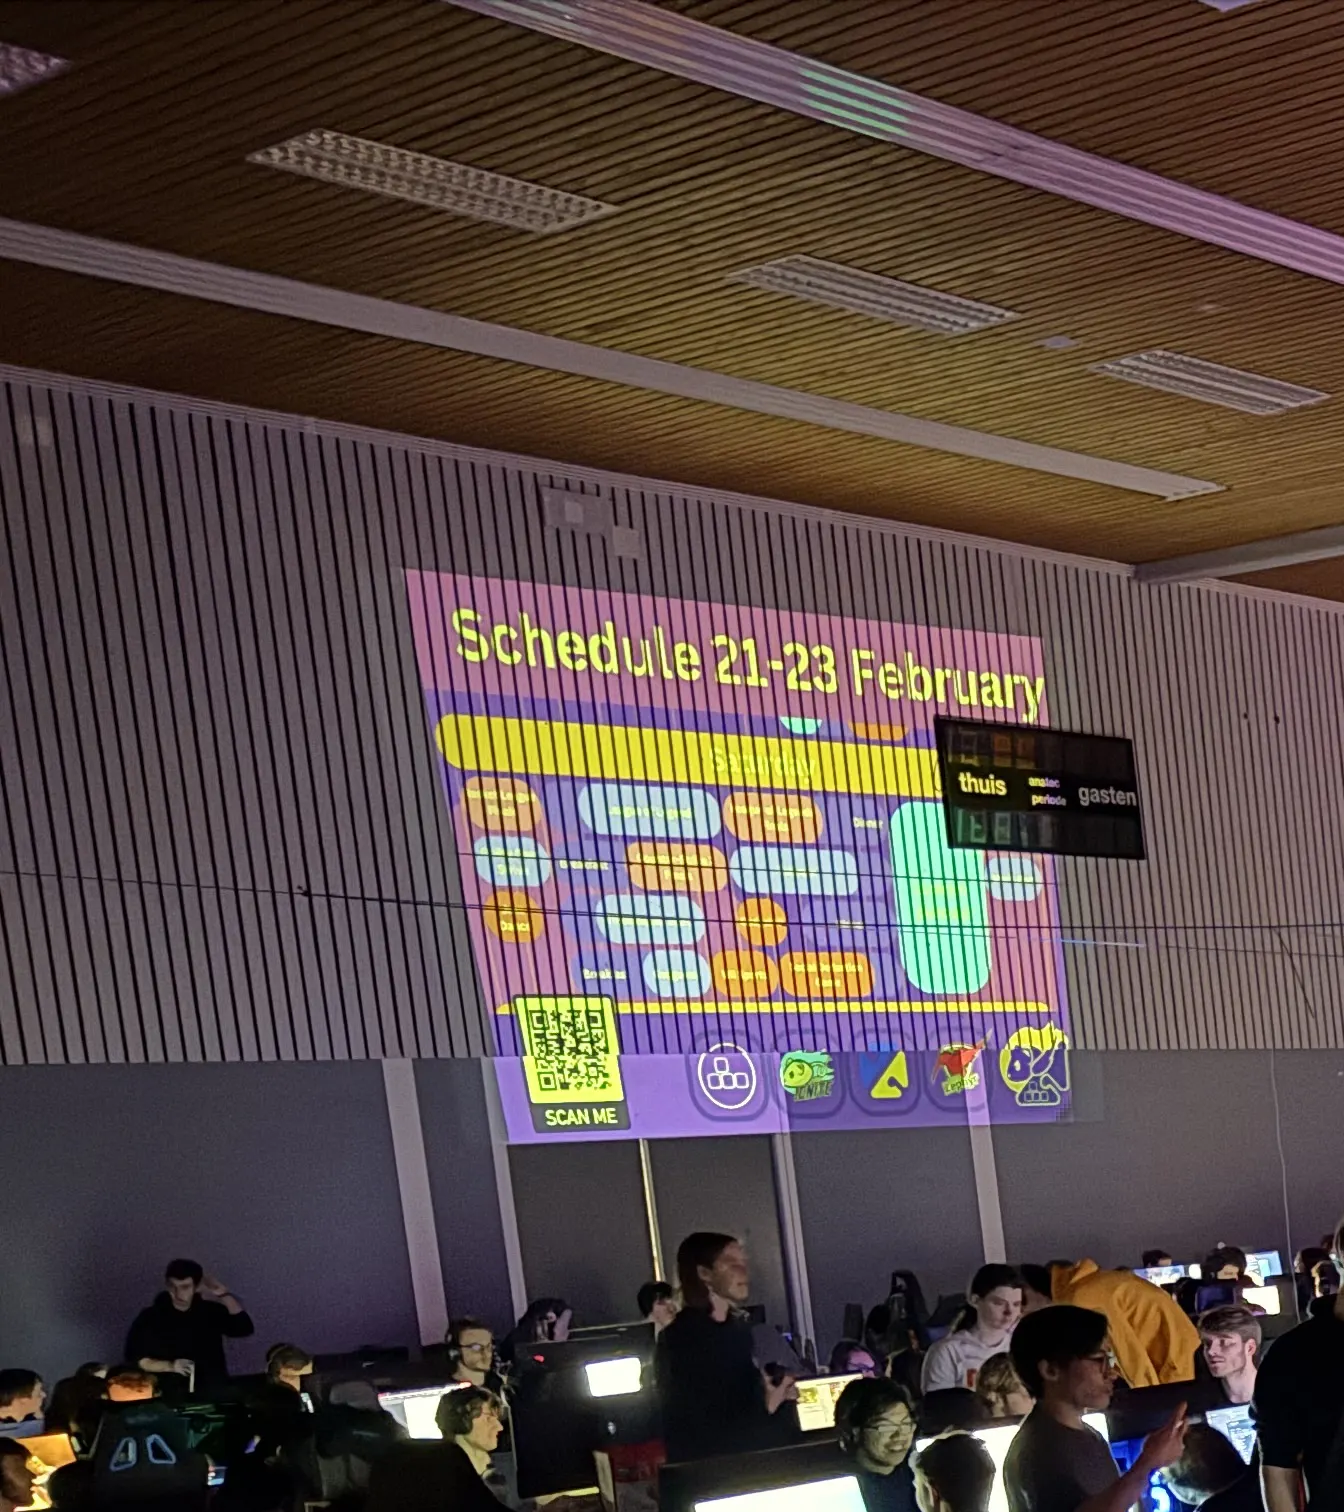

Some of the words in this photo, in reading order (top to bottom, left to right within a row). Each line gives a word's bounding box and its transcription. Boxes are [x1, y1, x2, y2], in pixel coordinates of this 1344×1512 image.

[452, 607, 701, 682] Schedule
[710, 633, 838, 695] 21-23
[851, 647, 1045, 725] February
[958, 771, 1008, 797] thuis
[1031, 793, 1067, 806] periode
[1078, 786, 1137, 807] gasten
[545, 1109, 590, 1126] SCAN
[592, 1107, 618, 1124] ME
